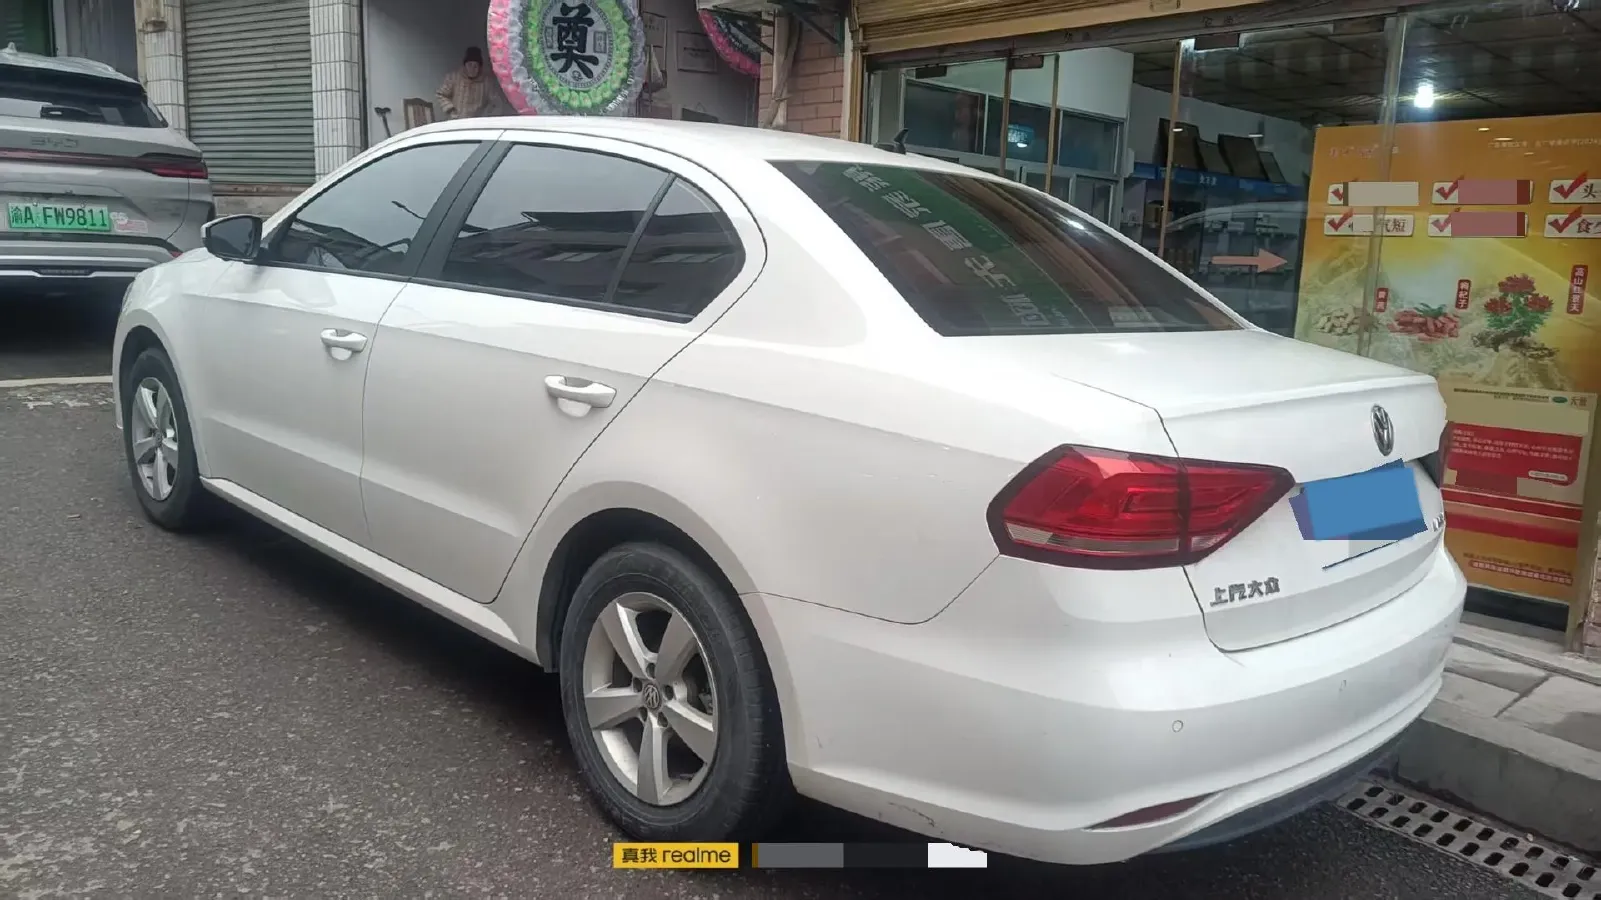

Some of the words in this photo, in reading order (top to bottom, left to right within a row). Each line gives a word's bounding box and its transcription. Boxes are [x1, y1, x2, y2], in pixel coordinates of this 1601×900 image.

[549, 2, 600, 79] 奠
[31, 136, 79, 149] BYD
[1582, 183, 1601, 199] 头
[42, 207, 108, 228] FW9811
[1209, 577, 1281, 607] 上汽大众
